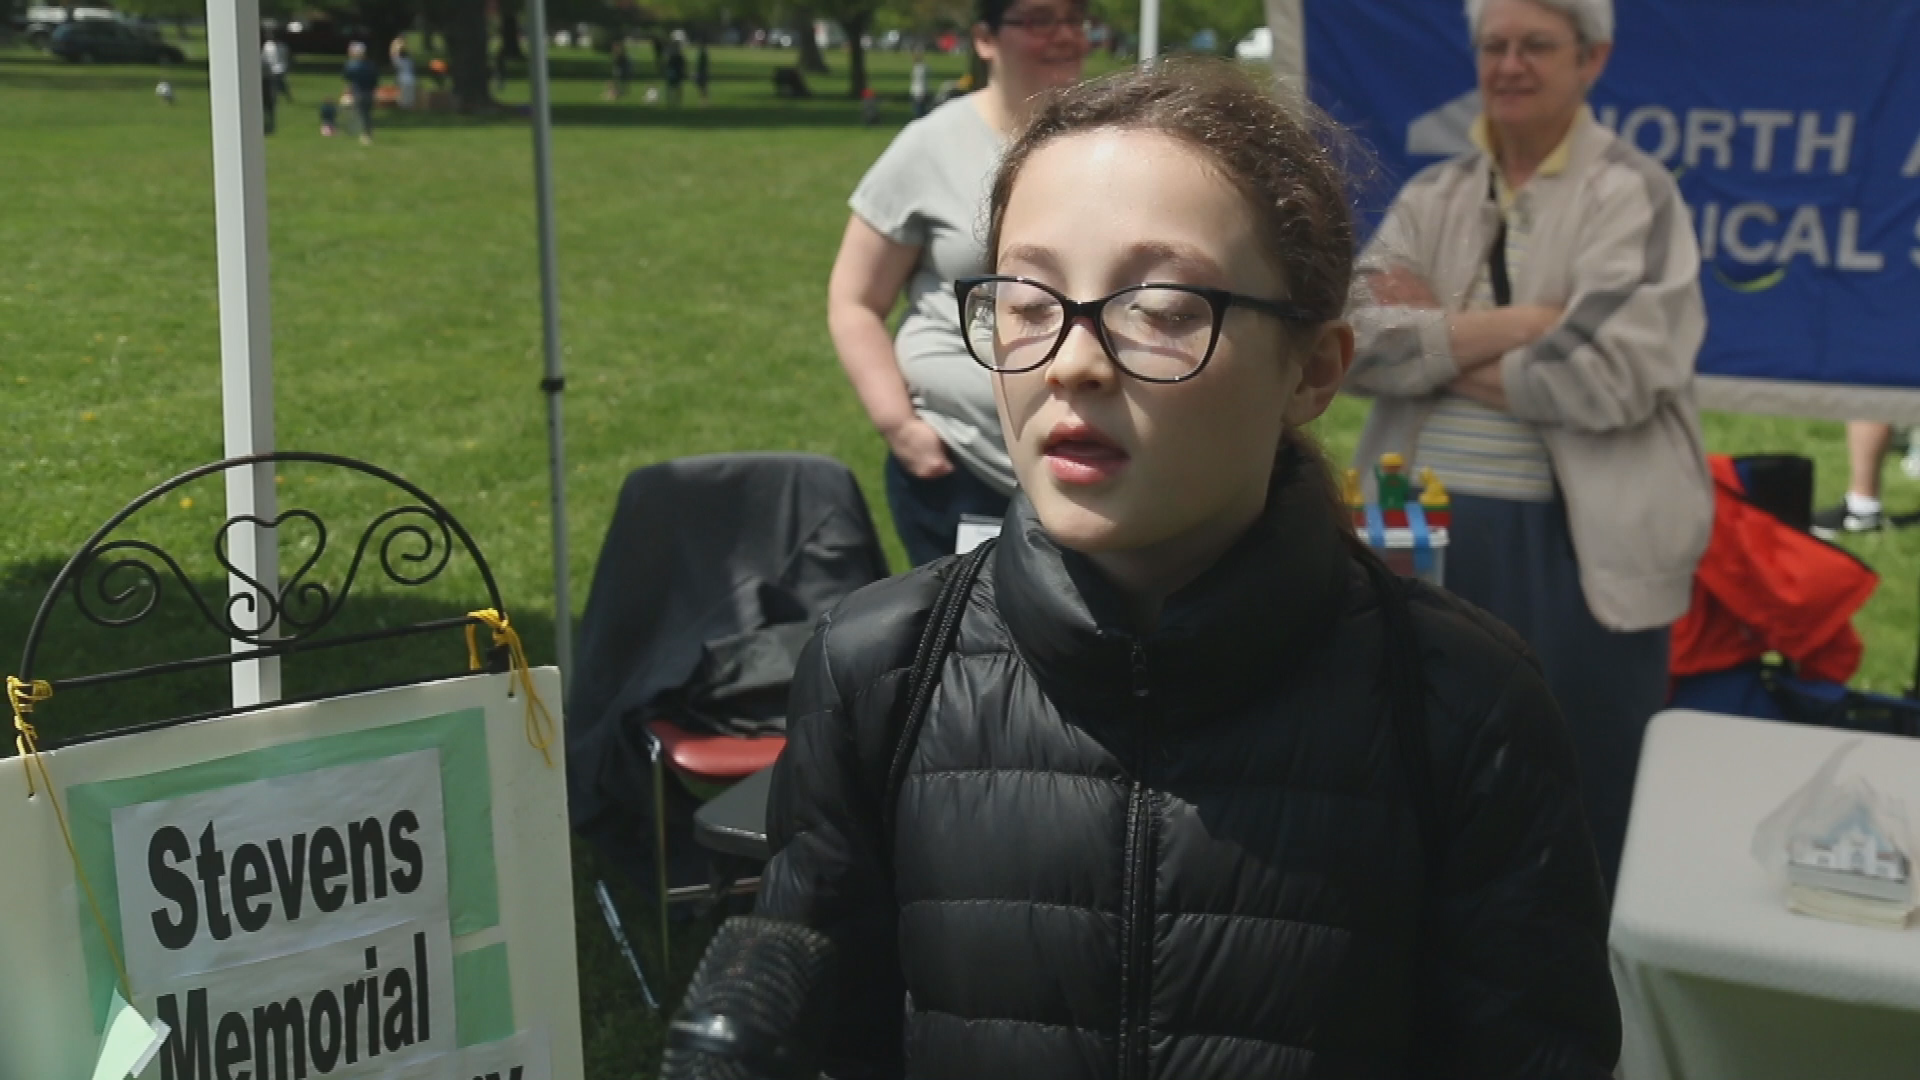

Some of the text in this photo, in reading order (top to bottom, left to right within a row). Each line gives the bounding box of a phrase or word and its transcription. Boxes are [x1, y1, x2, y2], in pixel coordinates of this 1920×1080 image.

[1600, 105, 1856, 175] ORTH
[1692, 202, 1884, 271] ICAL
[147, 808, 424, 950] Stevens
[155, 931, 431, 1080] Memorial
